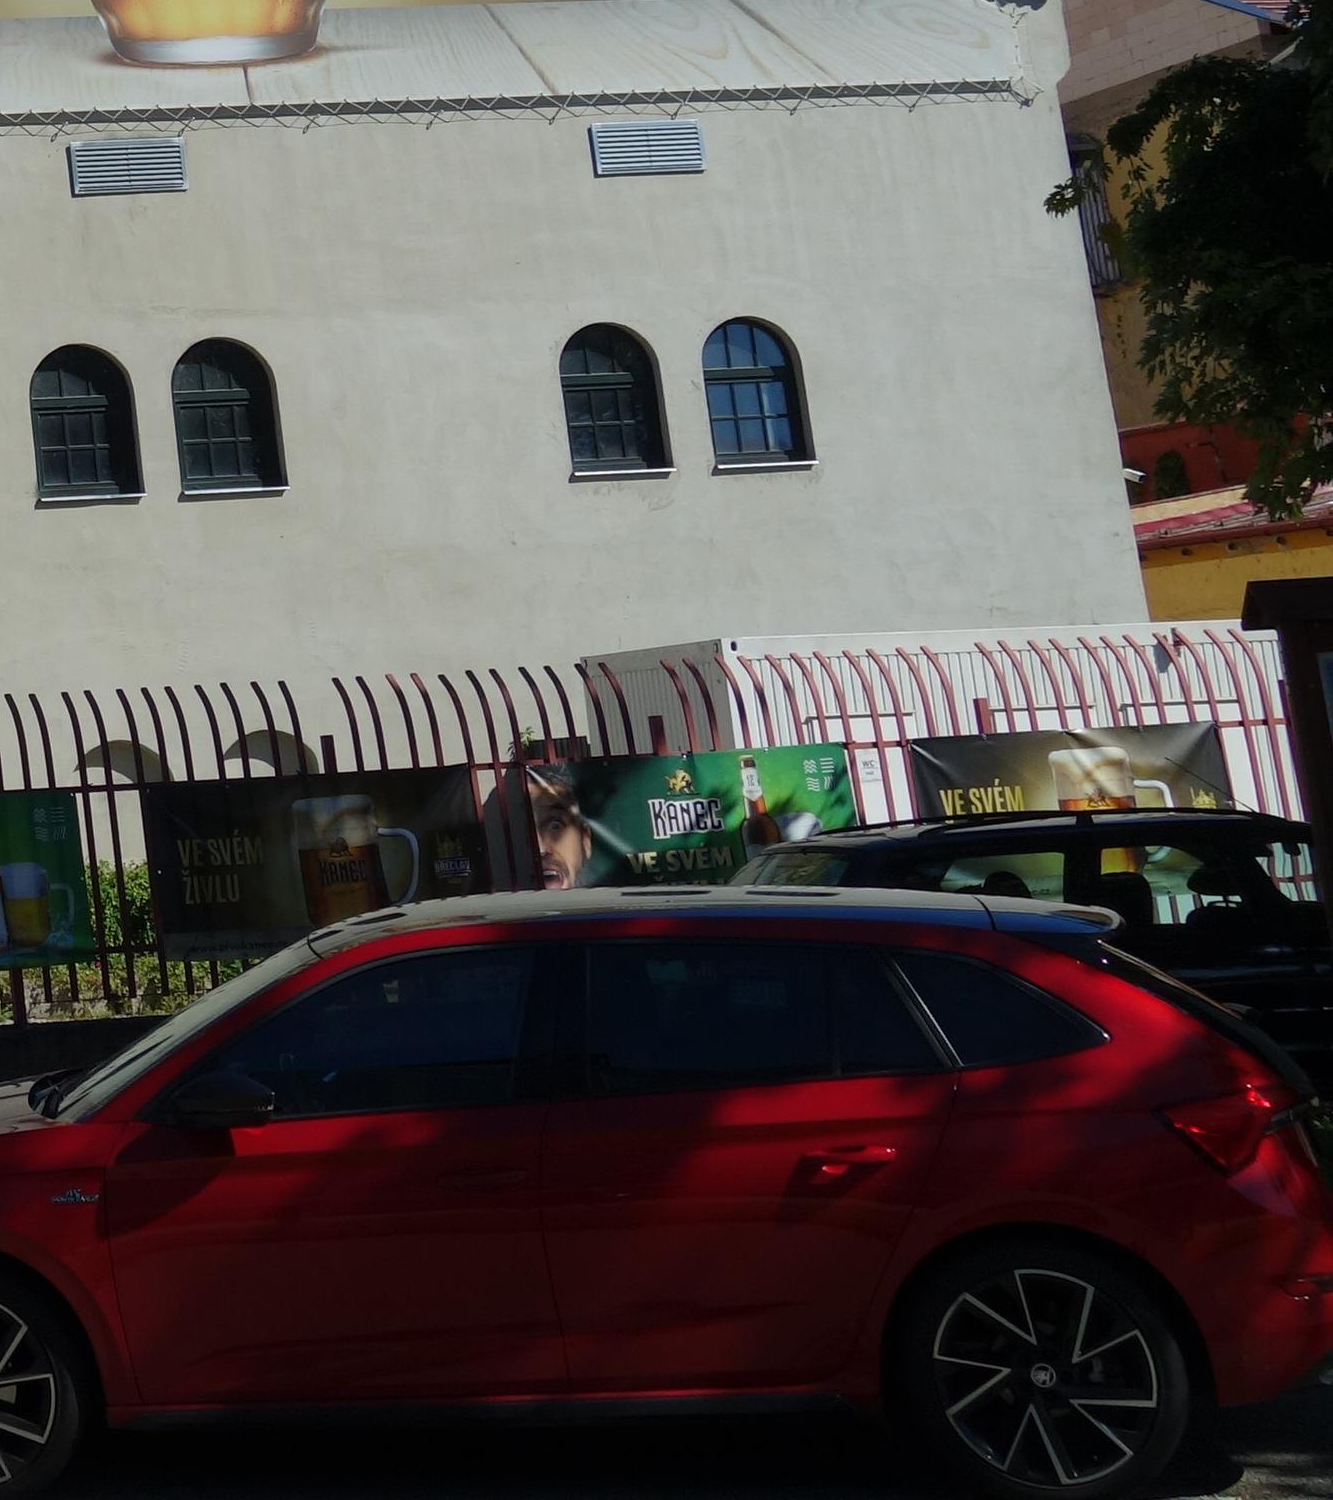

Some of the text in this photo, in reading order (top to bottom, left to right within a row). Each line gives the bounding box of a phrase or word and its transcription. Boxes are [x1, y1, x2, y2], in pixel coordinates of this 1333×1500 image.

[939, 778, 1024, 817] VE SVÉM
[648, 799, 725, 839] KANEC
[177, 829, 262, 867] VE SVÉM
[627, 842, 733, 874] VE SVÉM
[181, 869, 240, 905] ŽIVLU
